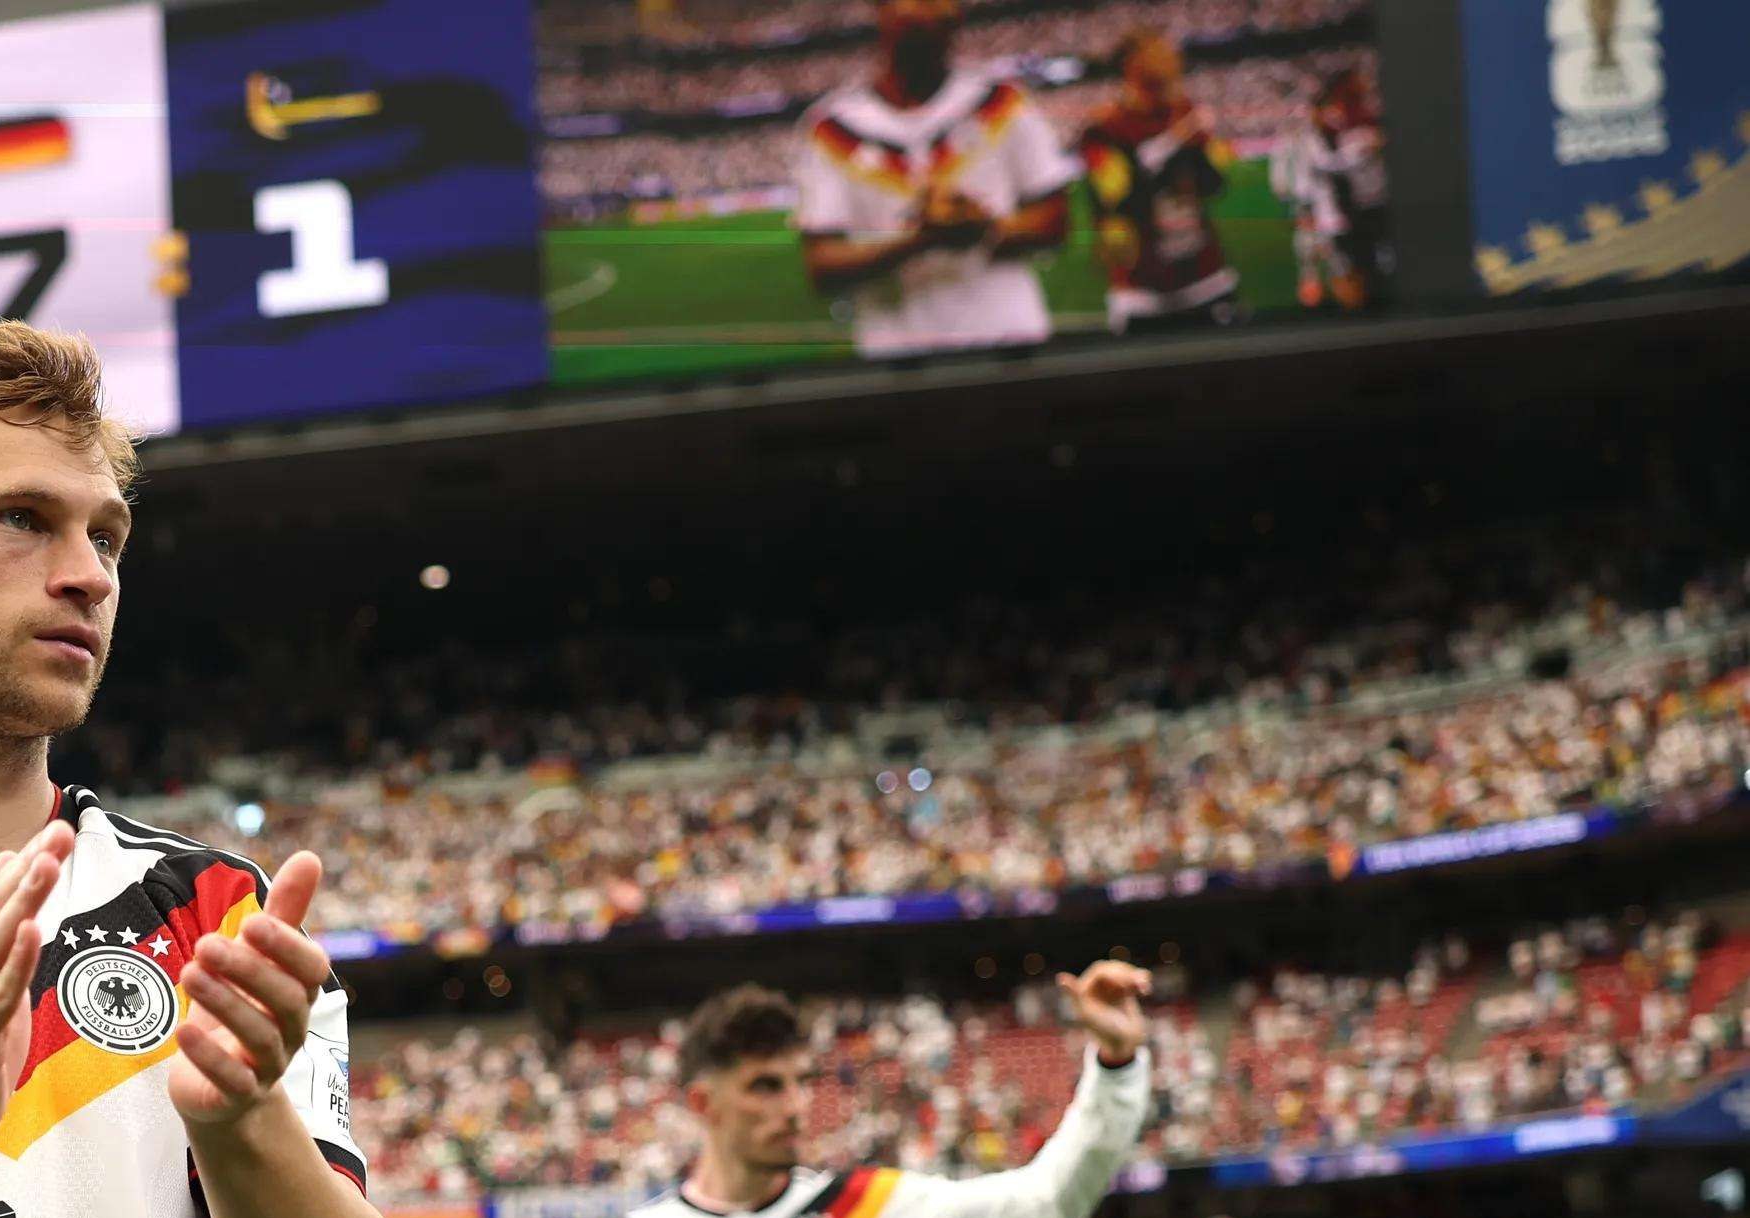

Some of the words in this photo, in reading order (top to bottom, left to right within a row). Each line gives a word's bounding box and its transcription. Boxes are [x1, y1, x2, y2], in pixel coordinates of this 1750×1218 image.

[255, 180, 389, 317] 1
[85, 961, 149, 982] DEUTSCHER
[81, 1004, 159, 1037] FUSSBALL-BUND
